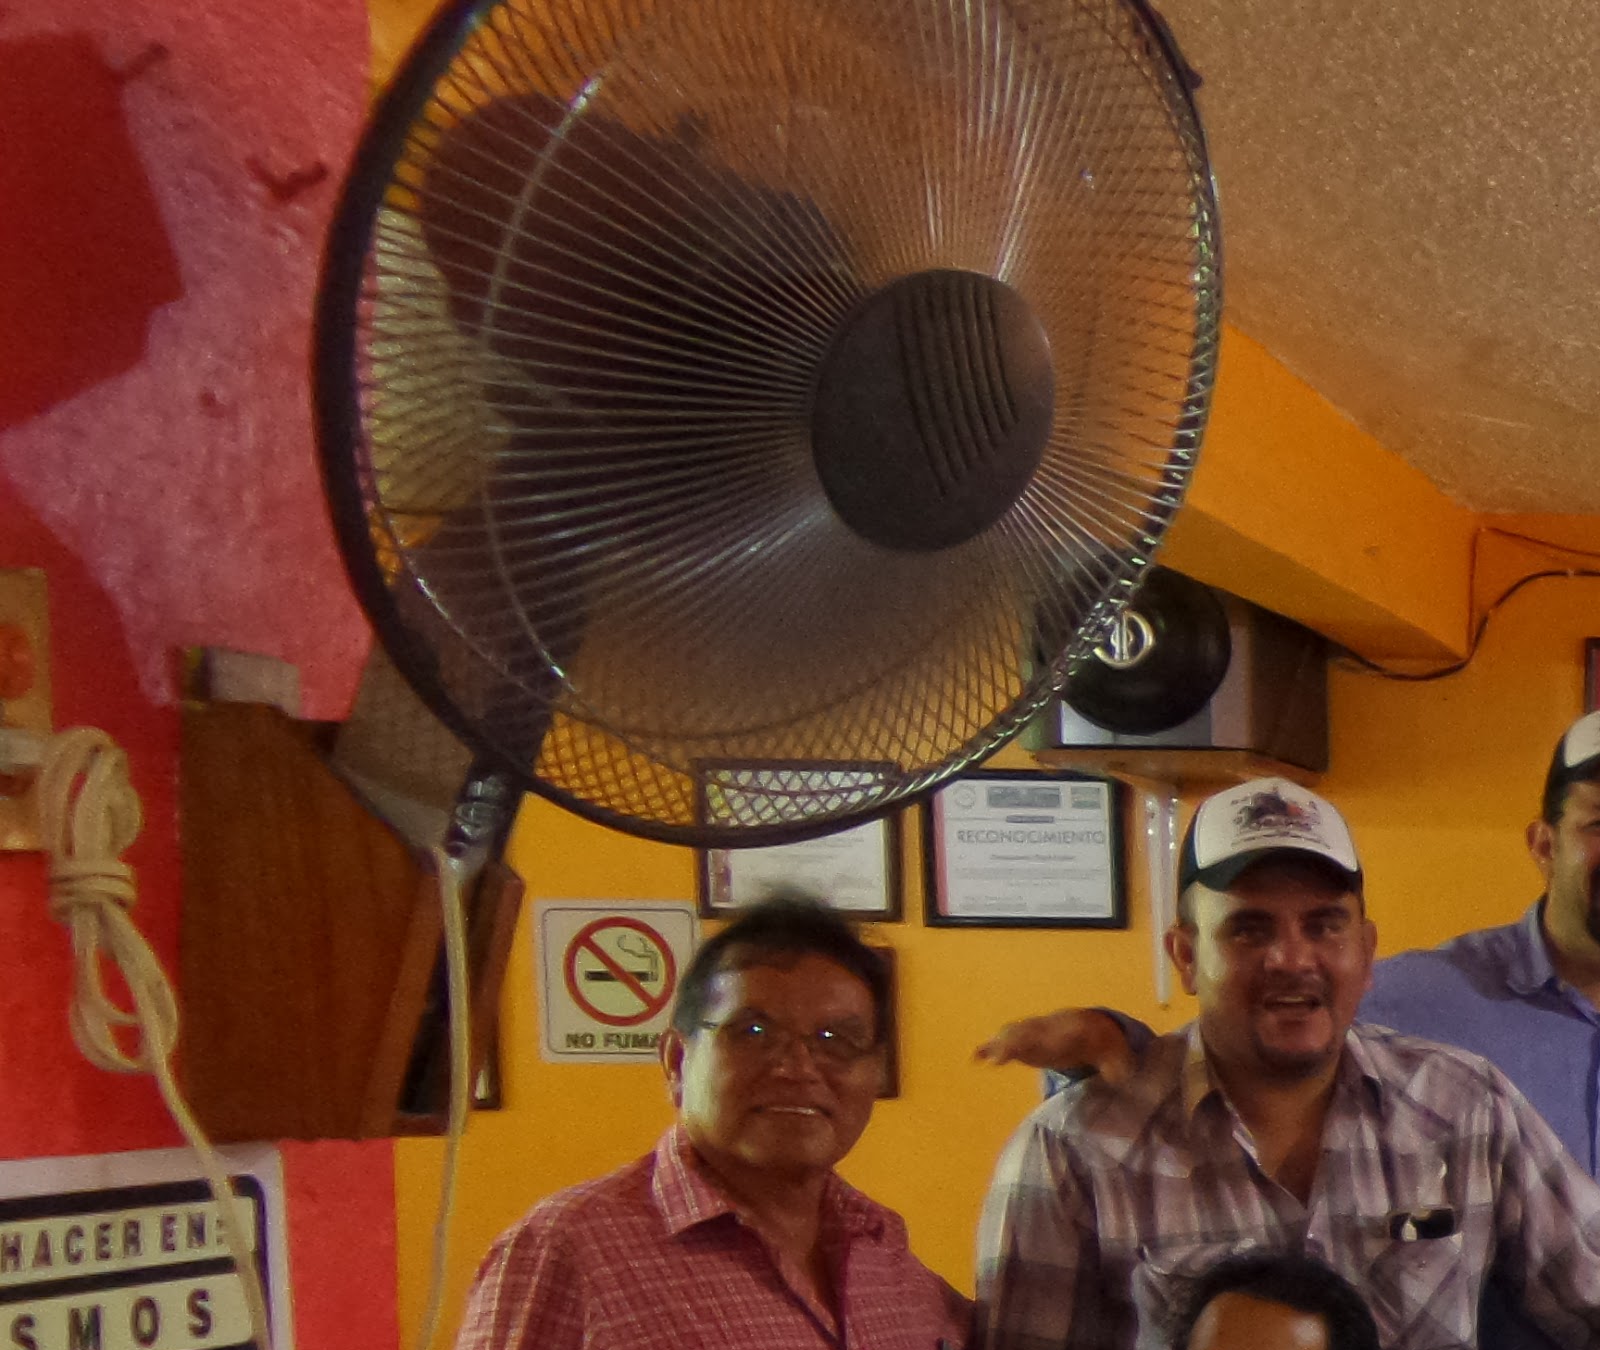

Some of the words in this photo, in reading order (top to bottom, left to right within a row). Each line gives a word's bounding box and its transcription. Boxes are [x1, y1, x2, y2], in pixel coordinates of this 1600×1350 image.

[957, 829, 1105, 845] RECONOCIMIENTO
[566, 1033, 595, 1049] NO
[0, 1218, 142, 1274] HACER
